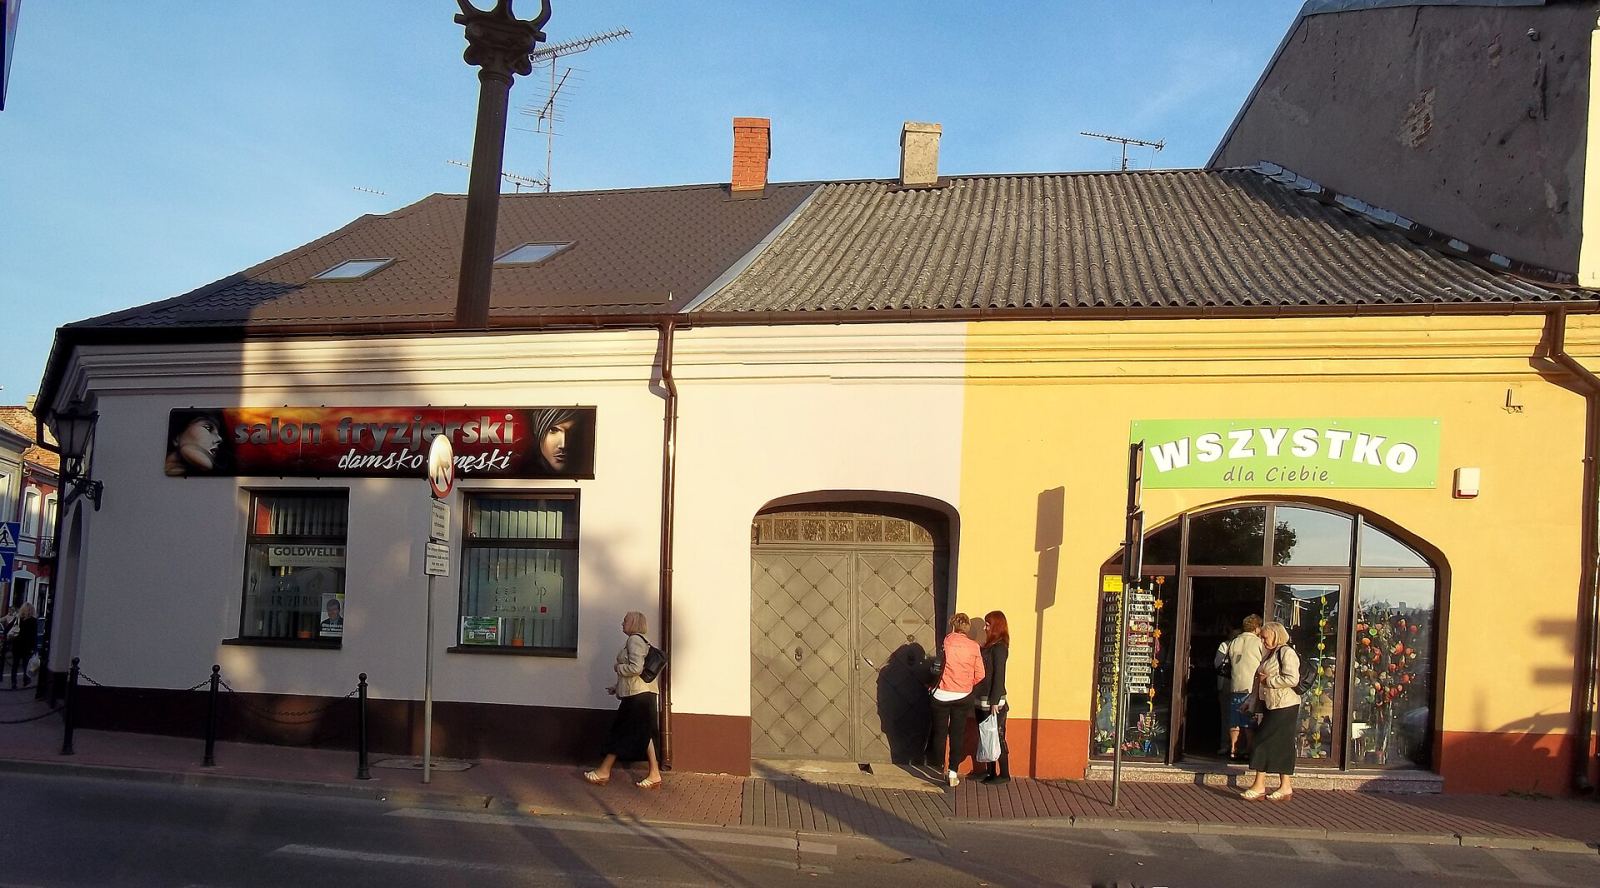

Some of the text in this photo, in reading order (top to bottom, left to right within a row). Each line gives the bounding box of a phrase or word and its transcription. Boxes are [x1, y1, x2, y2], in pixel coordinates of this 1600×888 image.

[234, 413, 515, 453] salon fryzjerski
[337, 448, 423, 470] damsko
[1149, 427, 1419, 474] WSZYSTKO
[1223, 466, 1329, 482] dla Ciebie
[273, 546, 336, 557] GOLDWELL
